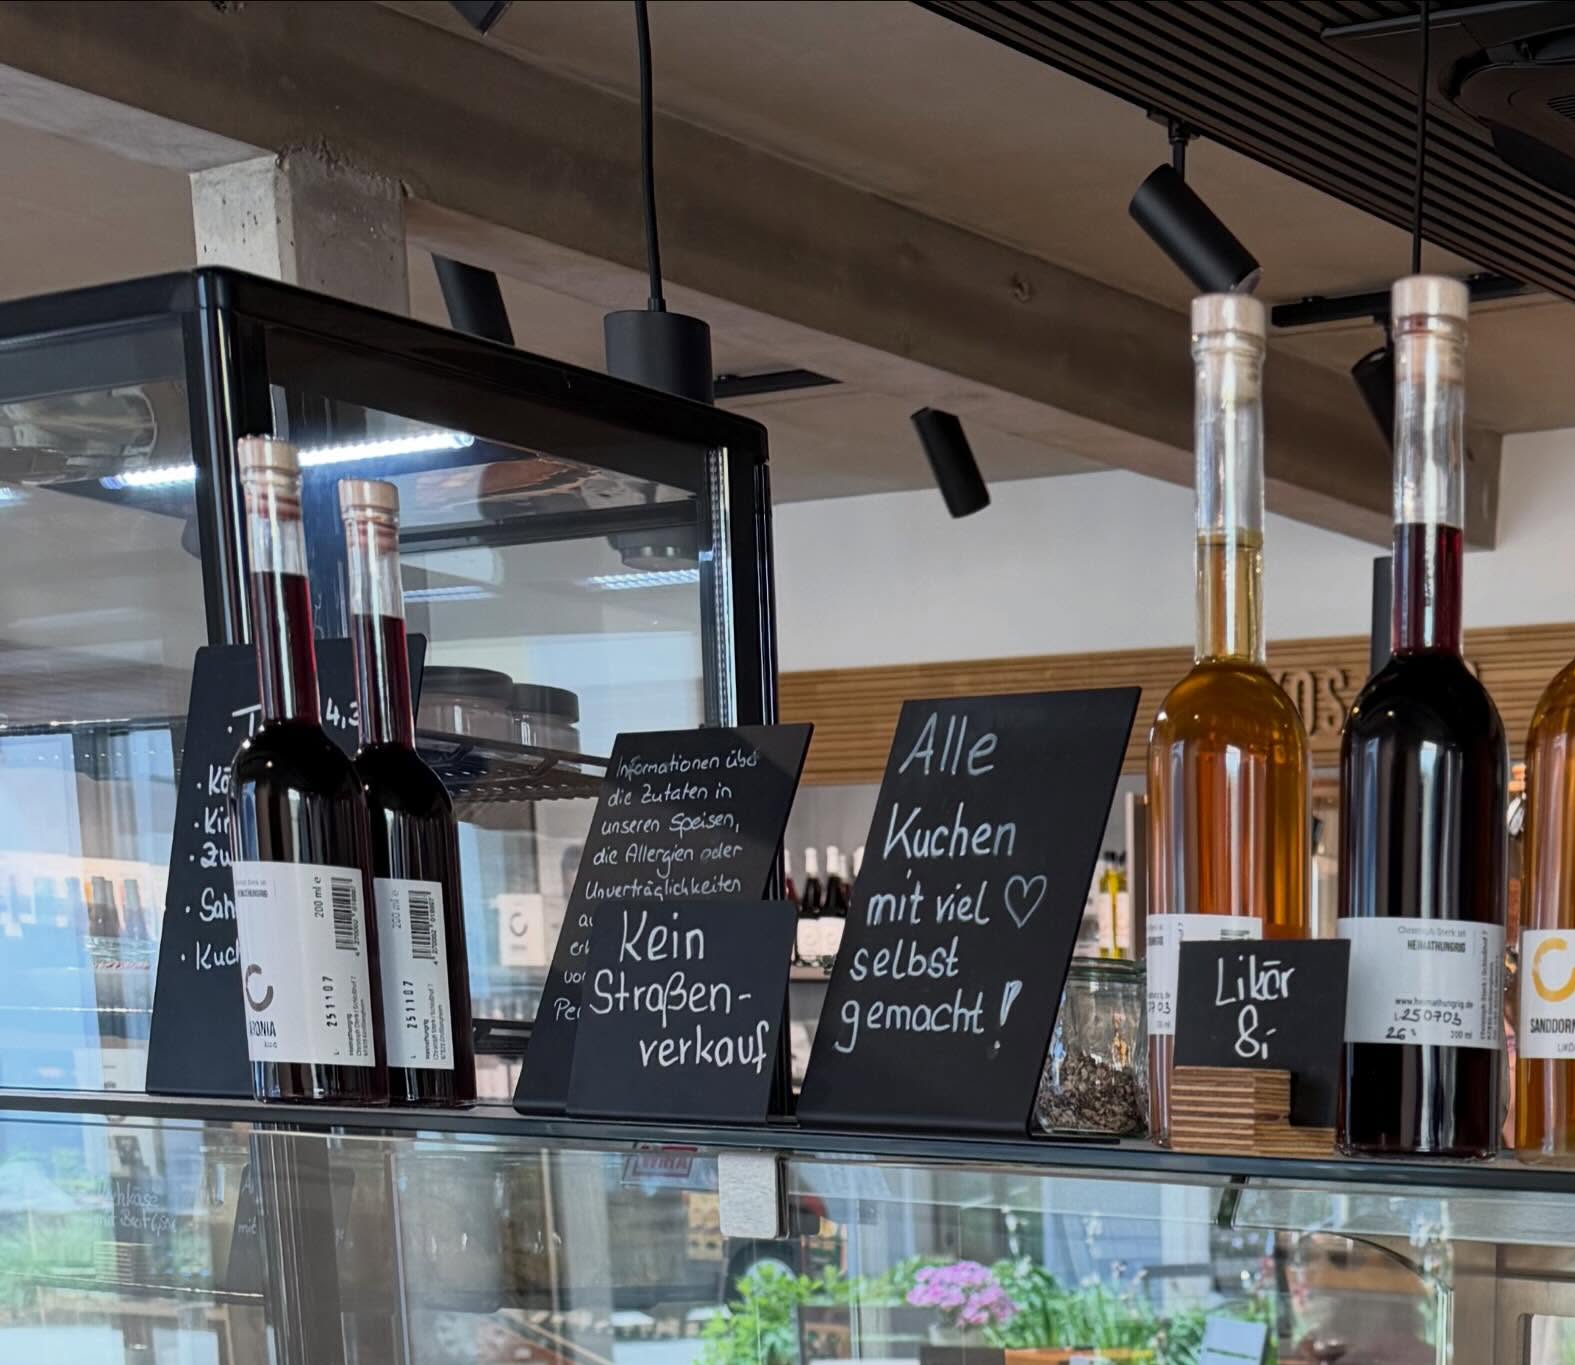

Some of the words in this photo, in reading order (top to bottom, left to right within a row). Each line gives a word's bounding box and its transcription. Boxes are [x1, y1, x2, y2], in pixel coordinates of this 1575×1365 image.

[616, 753, 720, 783] Informationen
[899, 711, 998, 776] Alle
[608, 788, 632, 807] die
[641, 783, 708, 804] Zutaten
[714, 784, 733, 799] in
[601, 817, 660, 835] unseren
[882, 801, 1018, 861] Kuchen
[593, 848, 618, 866] die
[625, 843, 694, 878] Allergien
[700, 843, 743, 864] oder
[585, 879, 742, 901] Unverträglichkeiten
[866, 868, 925, 927] mit
[935, 880, 991, 926] viel
[619, 910, 705, 962] Kein
[850, 936, 960, 982] selbst
[322, 976, 338, 1028] 251107
[589, 968, 752, 1028] Straßen-
[1215, 954, 1296, 1007] Likör
[639, 1020, 770, 1075] verkauf
